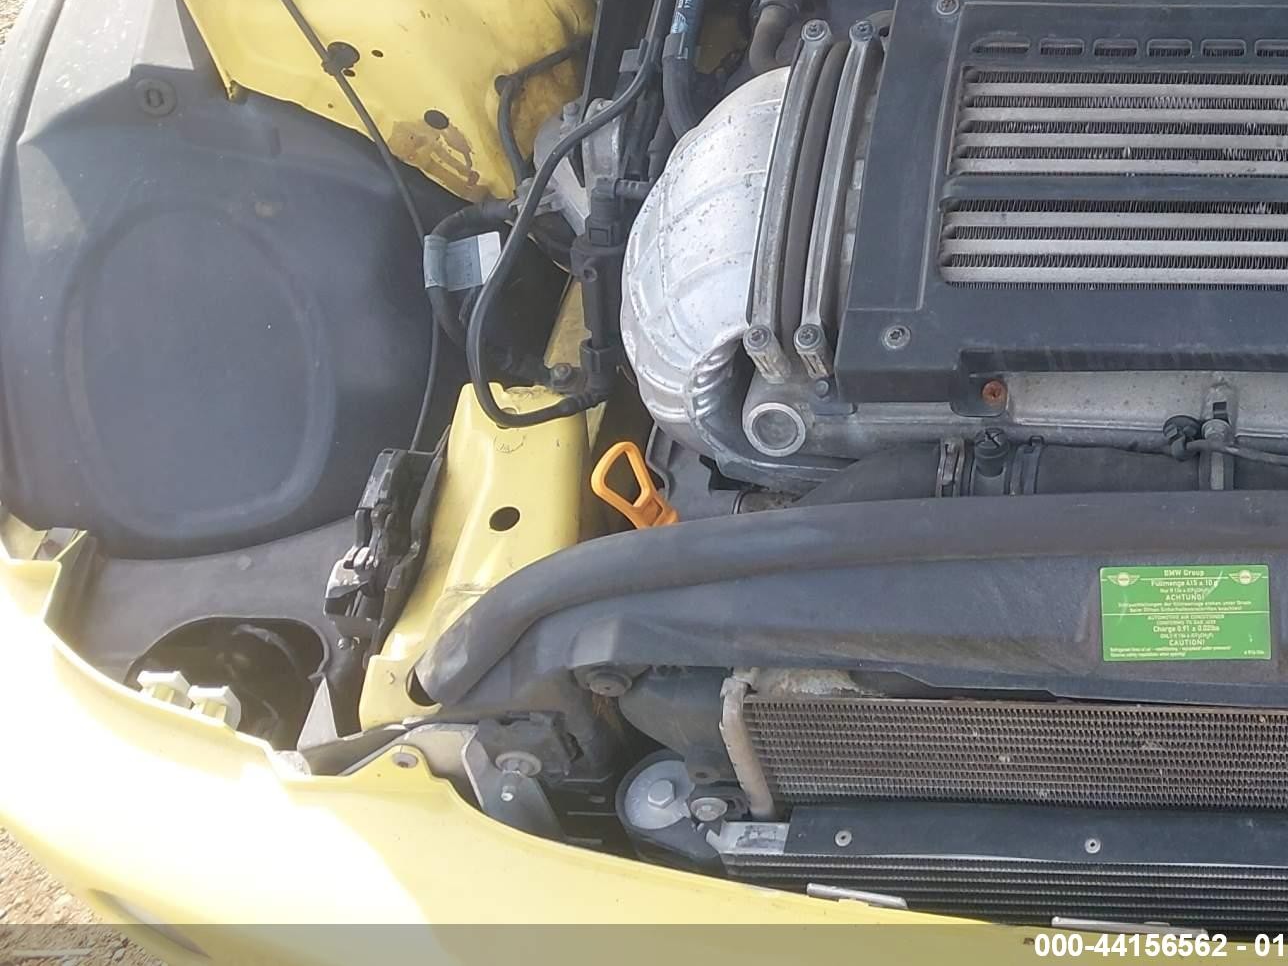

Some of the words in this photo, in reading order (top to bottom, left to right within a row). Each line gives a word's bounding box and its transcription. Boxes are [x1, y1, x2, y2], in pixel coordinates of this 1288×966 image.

[1164, 569, 1182, 577] BMW
[1184, 569, 1204, 577] Group
[1153, 625, 1176, 633] Charge
